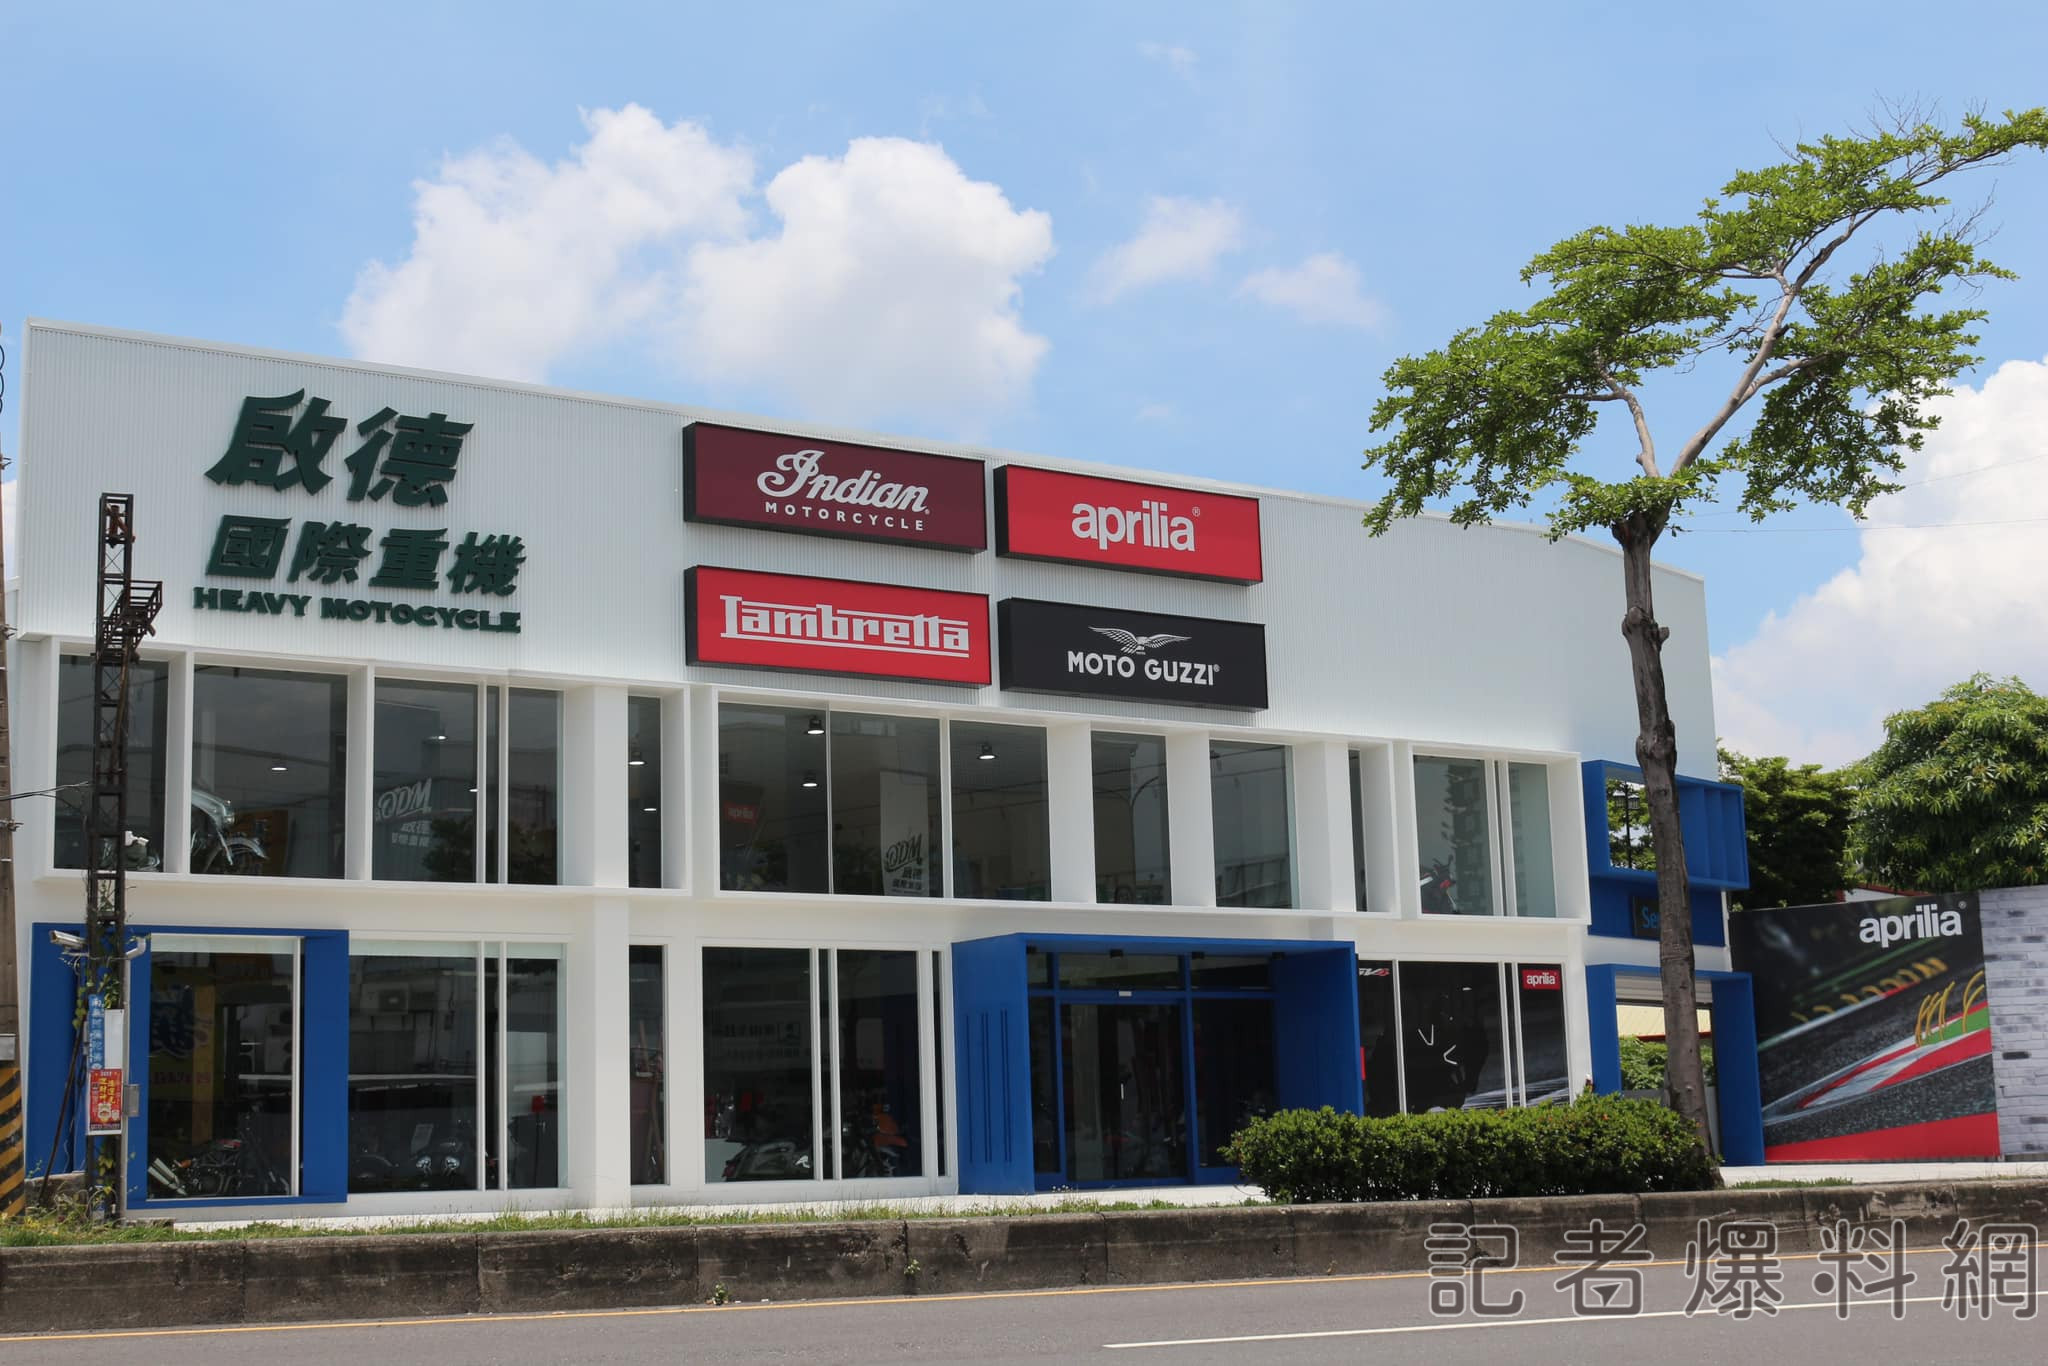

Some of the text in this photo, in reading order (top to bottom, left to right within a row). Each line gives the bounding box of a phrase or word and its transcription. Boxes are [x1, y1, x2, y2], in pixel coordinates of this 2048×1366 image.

[204, 387, 474, 508] 啟德
[757, 448, 930, 513] Indian
[765, 502, 924, 532] MOTORCYCLE
[1071, 501, 1196, 552] aprilia
[205, 514, 527, 597] 國際重機
[193, 586, 521, 634] HEAVY MOTOCYCLE
[719, 594, 970, 659] Lambretta
[1067, 651, 1215, 686] MOTO GUZZI
[1858, 903, 1963, 949] aprilia
[1526, 971, 1556, 987] aprilia
